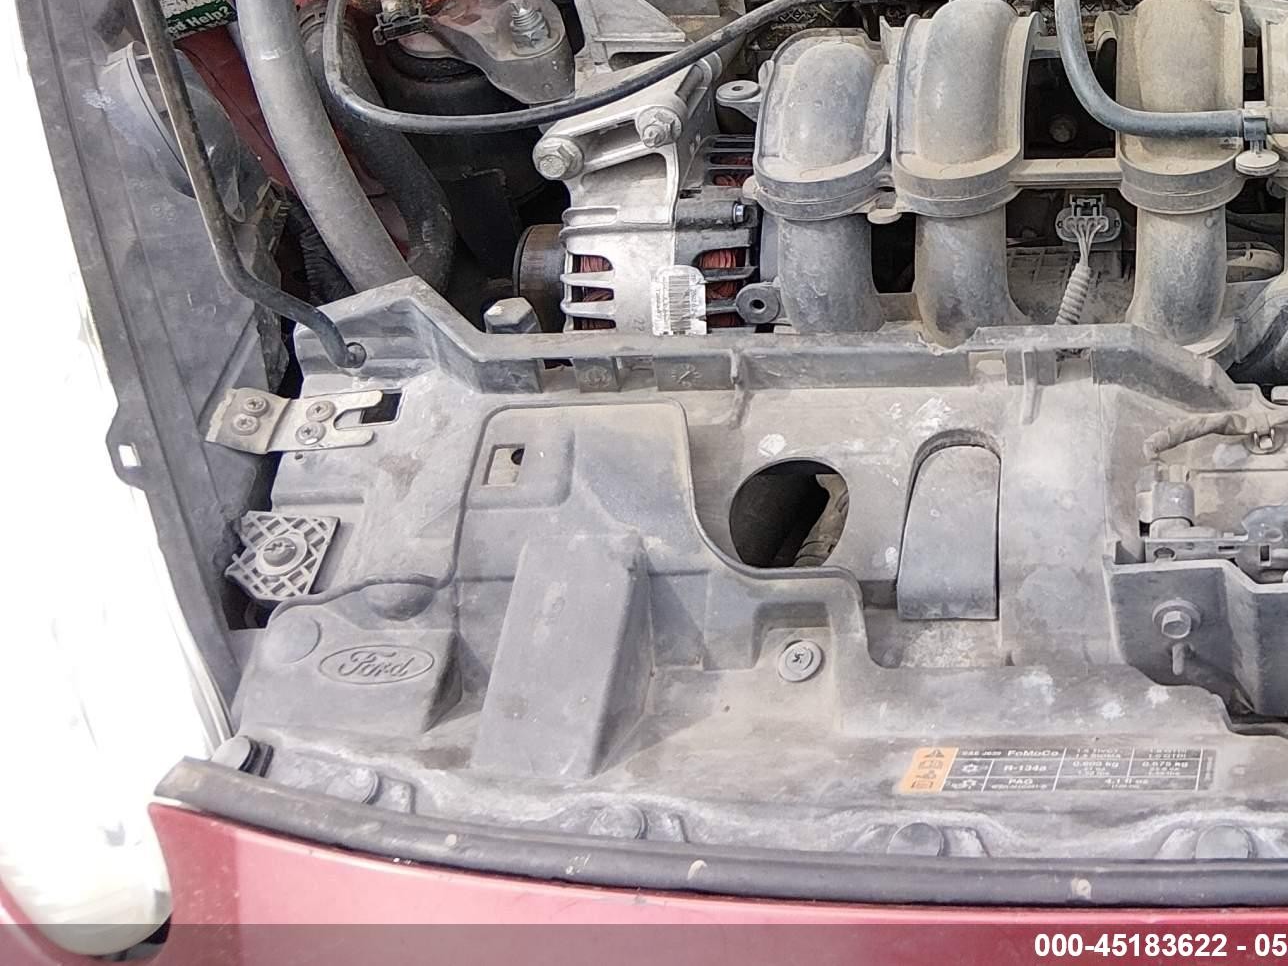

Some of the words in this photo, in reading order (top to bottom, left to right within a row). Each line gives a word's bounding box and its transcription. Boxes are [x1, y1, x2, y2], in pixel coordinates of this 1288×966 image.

[185, 5, 230, 27] Help?
[338, 650, 415, 677] Ford
[1003, 764, 1047, 772] R-134a
